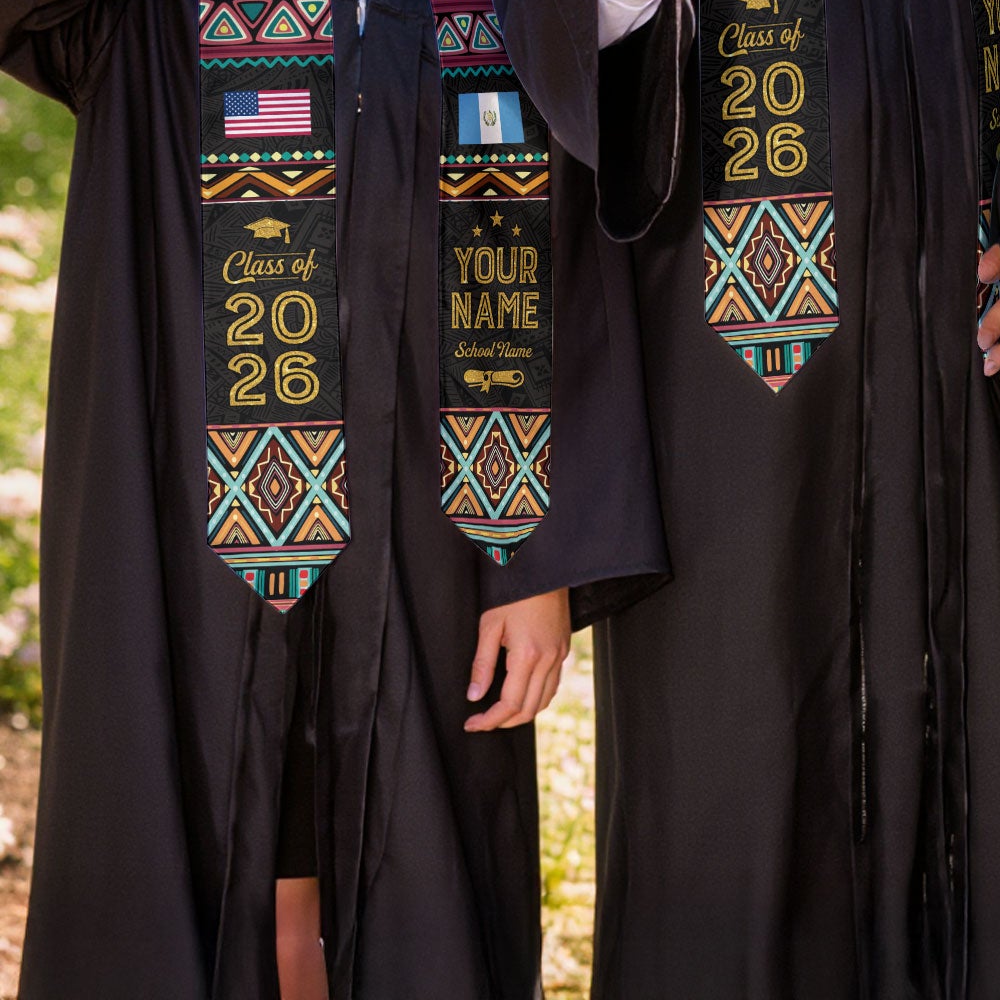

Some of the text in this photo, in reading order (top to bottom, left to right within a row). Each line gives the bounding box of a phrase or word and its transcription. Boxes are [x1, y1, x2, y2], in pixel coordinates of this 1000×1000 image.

[718, 17, 805, 58] Class of
[720, 60, 805, 121] 20
[722, 122, 808, 182] 26
[222, 248, 319, 285] Class of
[453, 246, 538, 285] YOUR
[224, 289, 318, 347] 20
[451, 291, 540, 329] NAME
[454, 340, 533, 358] School Name
[227, 350, 320, 407] 26
